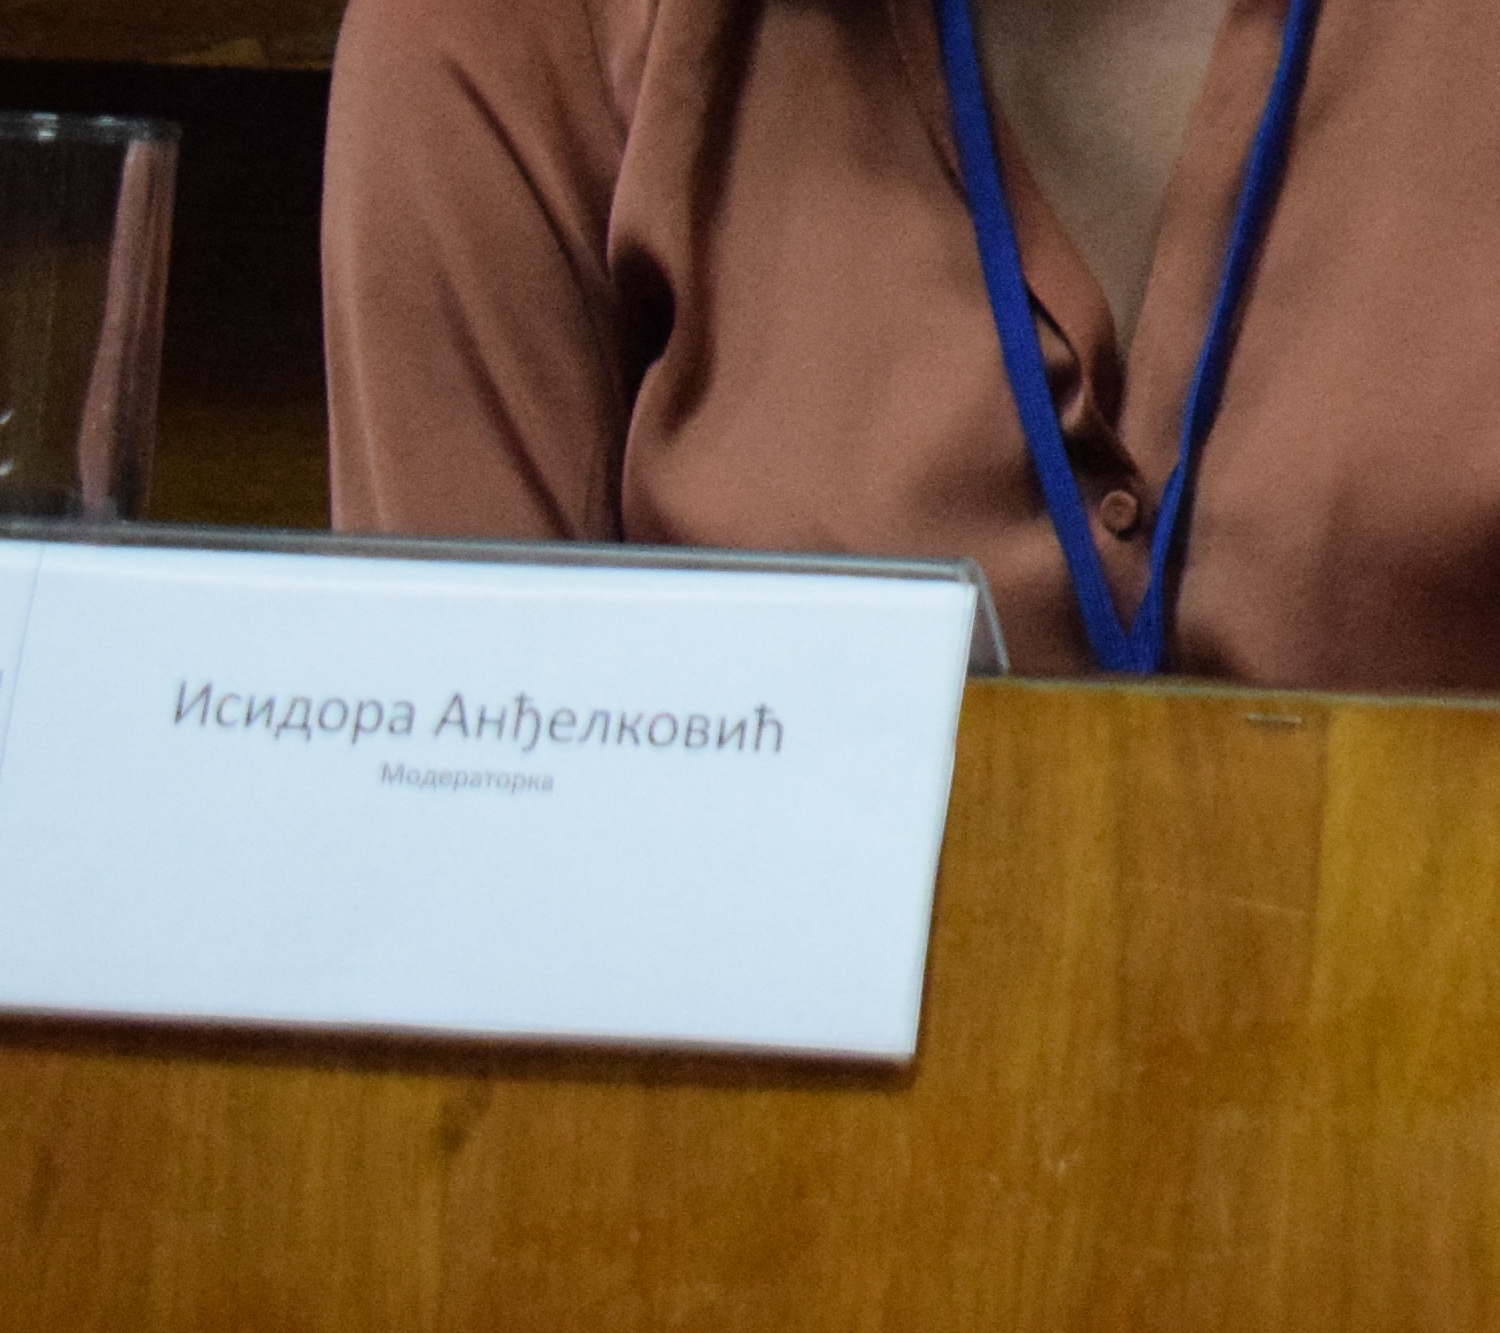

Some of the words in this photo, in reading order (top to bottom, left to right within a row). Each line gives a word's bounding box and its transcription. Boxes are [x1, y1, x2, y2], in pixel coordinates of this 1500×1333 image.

[171, 679, 416, 745] Исидора
[434, 692, 785, 754] Анђелковић
[380, 762, 554, 794] Модераторка
